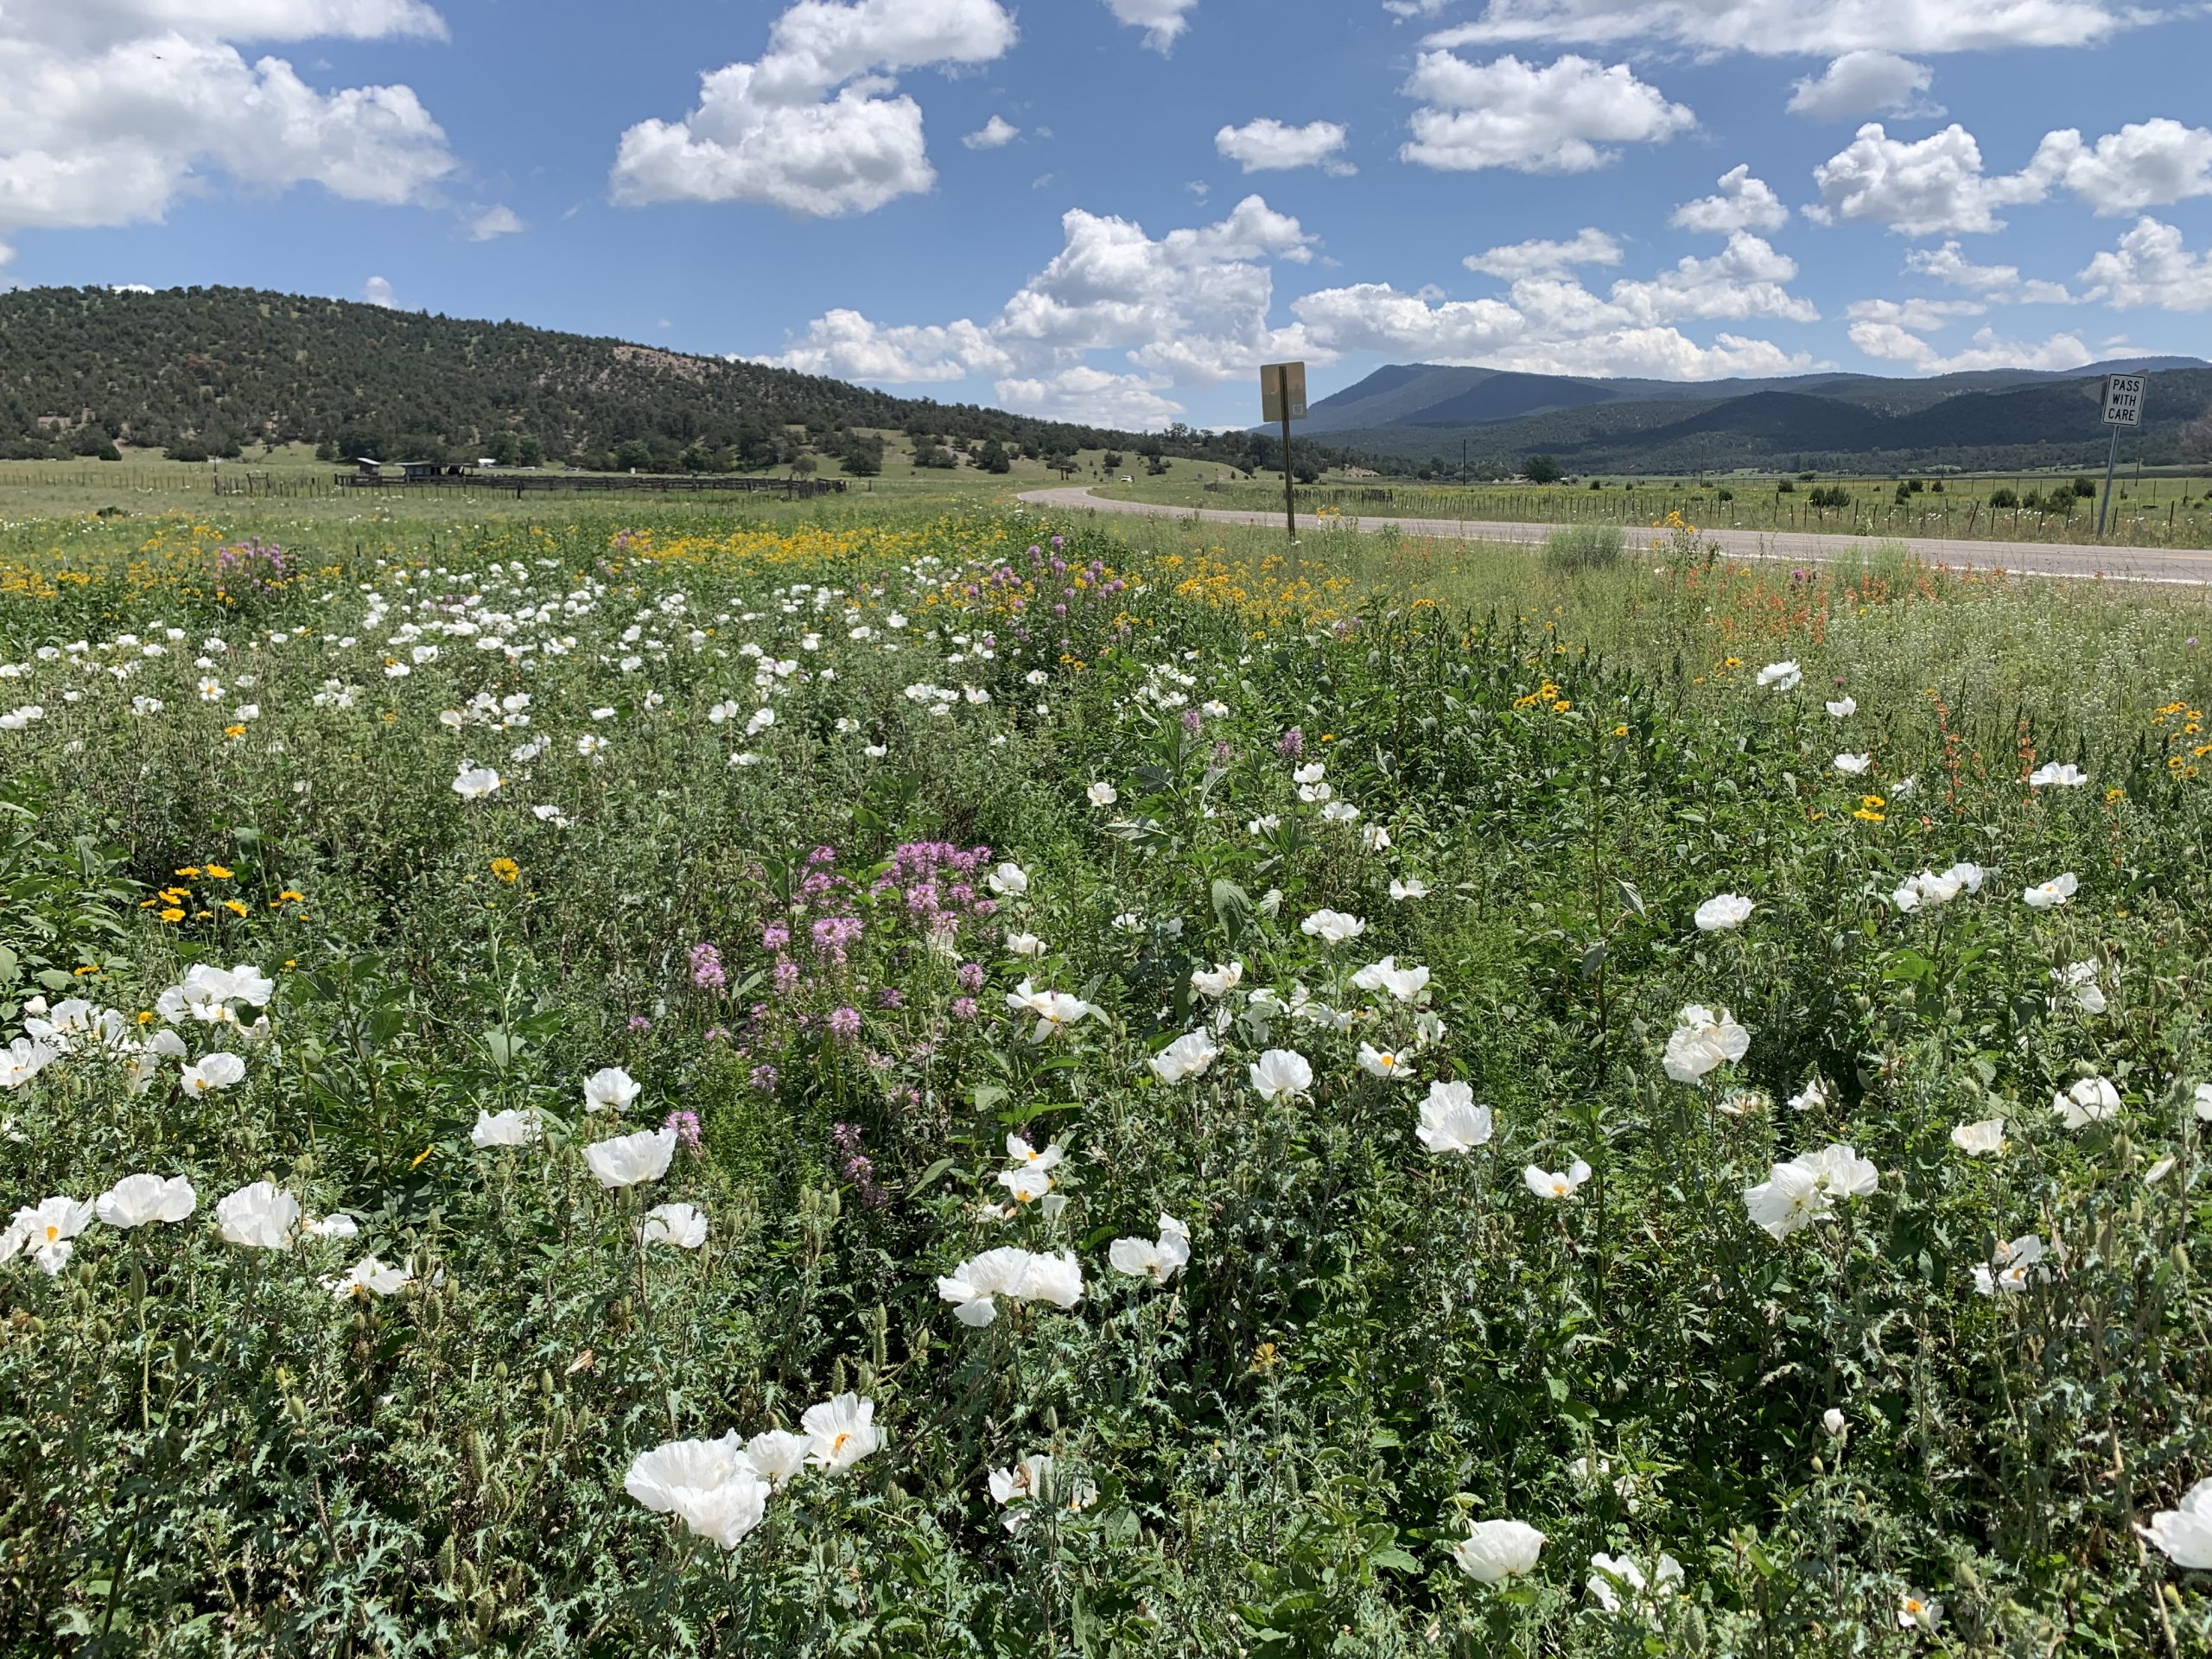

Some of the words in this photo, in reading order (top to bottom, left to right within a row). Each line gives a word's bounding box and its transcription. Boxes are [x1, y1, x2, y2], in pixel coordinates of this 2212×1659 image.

[2113, 379, 2139, 391] PASS
[2113, 394, 2136, 406] WITH
[2108, 408, 2135, 421] CARE
